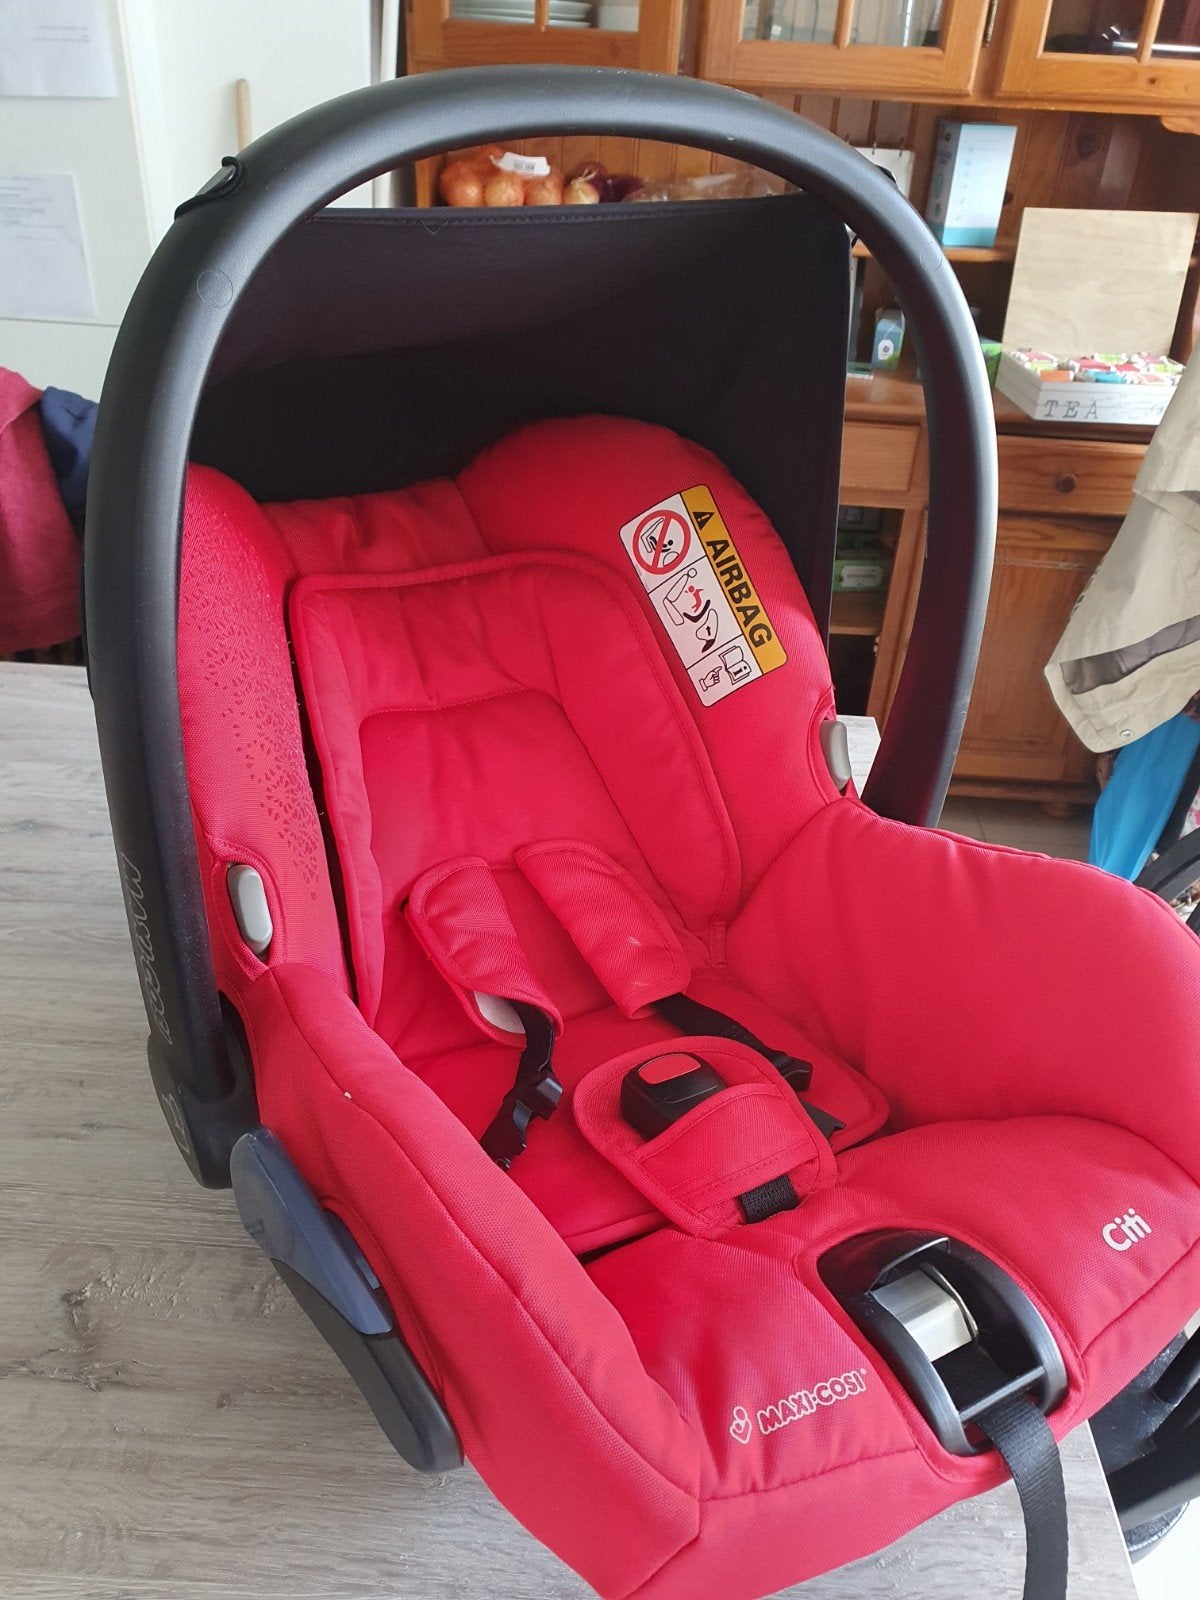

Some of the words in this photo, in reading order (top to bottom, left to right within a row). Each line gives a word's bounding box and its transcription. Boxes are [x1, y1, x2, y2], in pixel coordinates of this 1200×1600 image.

[1044, 401, 1098, 419] TEA
[706, 540, 773, 649] AIRBAG
[1102, 1207, 1153, 1251] Citi
